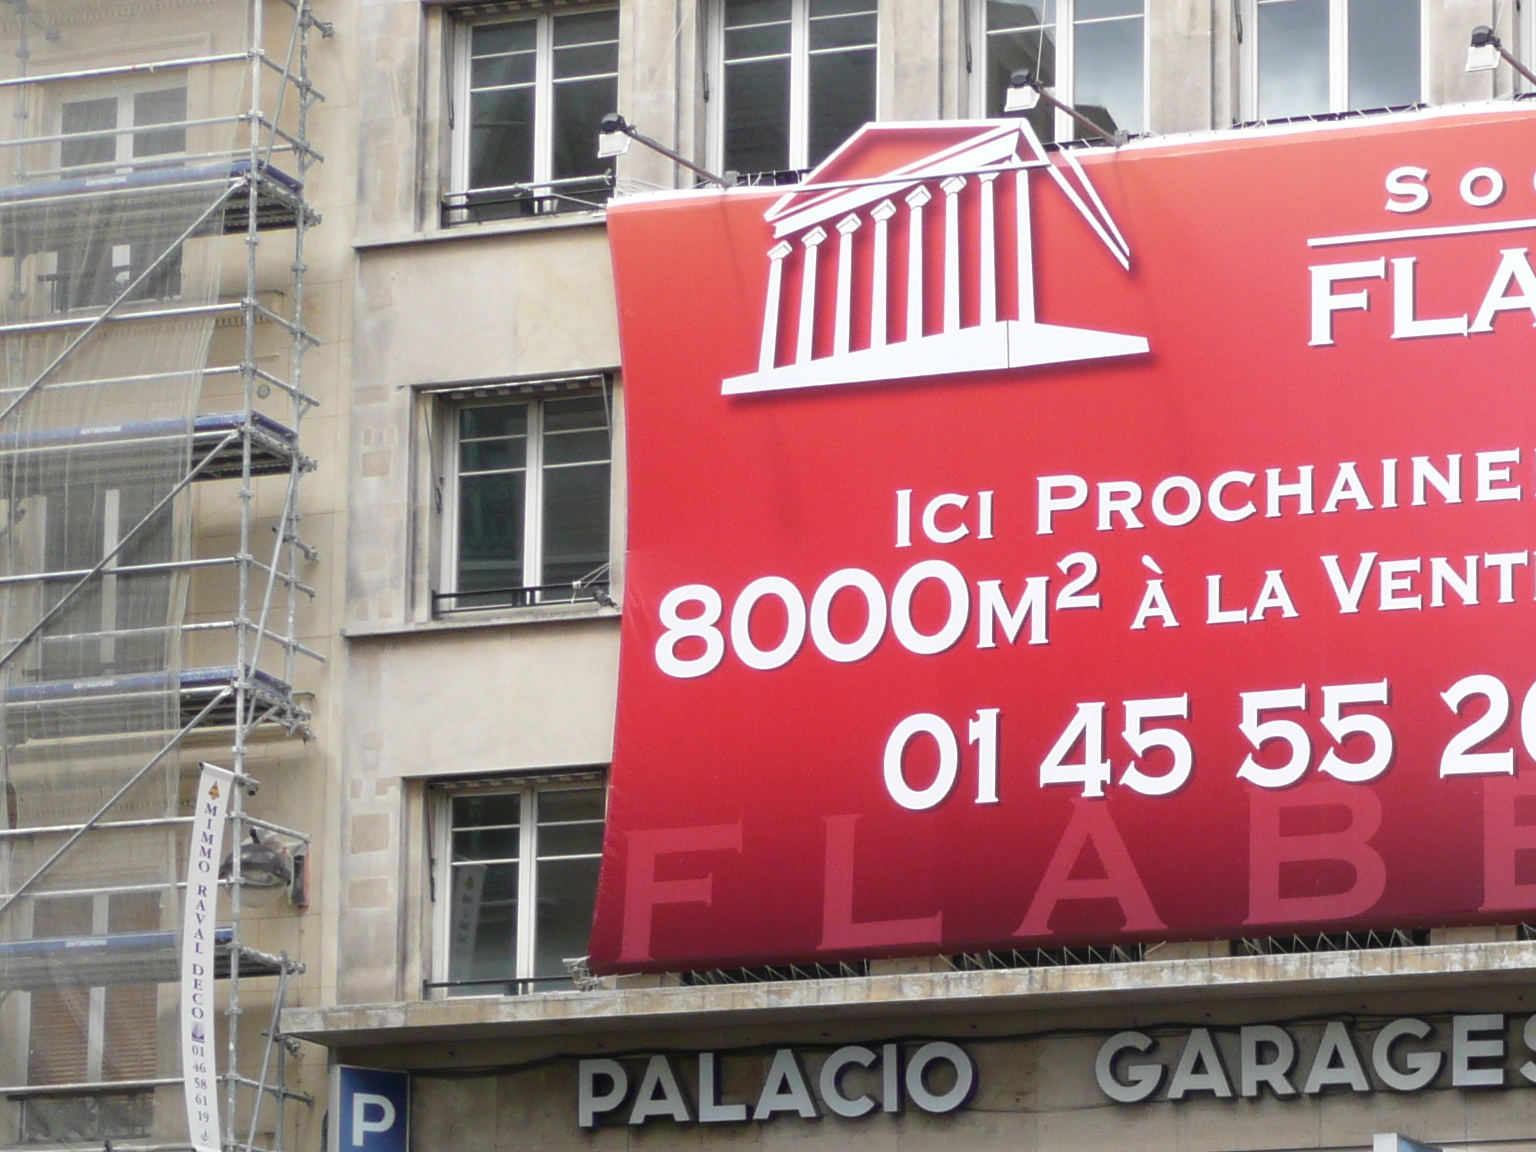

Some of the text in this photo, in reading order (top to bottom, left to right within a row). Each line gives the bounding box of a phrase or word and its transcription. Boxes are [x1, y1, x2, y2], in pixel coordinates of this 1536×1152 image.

[894, 488, 996, 549] ICI
[1130, 555, 1181, 630] À
[1205, 570, 1300, 625] LA
[883, 707, 1001, 811] 01
[1038, 692, 1193, 798] 45
[1236, 678, 1395, 789] 55
[198, 802, 218, 873] MIMMO
[193, 884, 208, 955] RAVAL
[191, 963, 204, 1019] DECO
[192, 1061, 206, 1074] 46
[193, 1077, 207, 1090] 58
[578, 1040, 974, 1128] PALACIO
[195, 1094, 208, 1107] 61
[197, 1110, 210, 1123] 19
